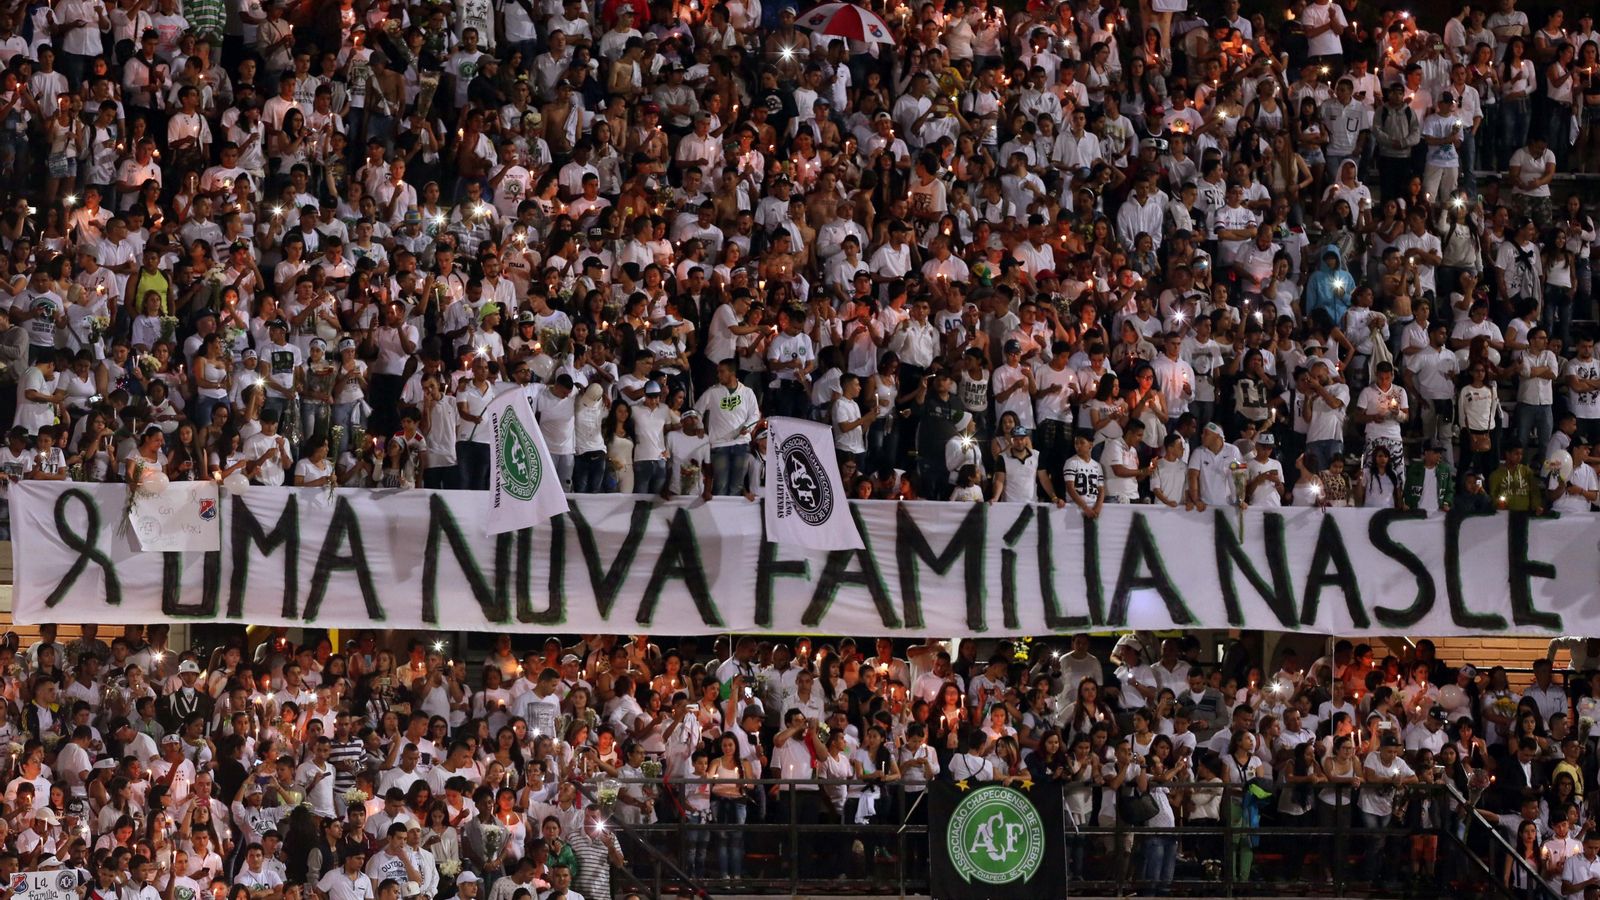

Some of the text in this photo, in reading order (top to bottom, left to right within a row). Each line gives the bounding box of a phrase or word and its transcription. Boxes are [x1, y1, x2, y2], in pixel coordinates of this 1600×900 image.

[1215, 507, 1563, 632] NASCE
[966, 789, 1030, 813] CHAPECOENSE
[1026, 811, 1037, 827] DE
[968, 811, 1025, 863] ACF
[1024, 826, 1042, 872] FUTEBOL
[34, 877, 49, 890] La
